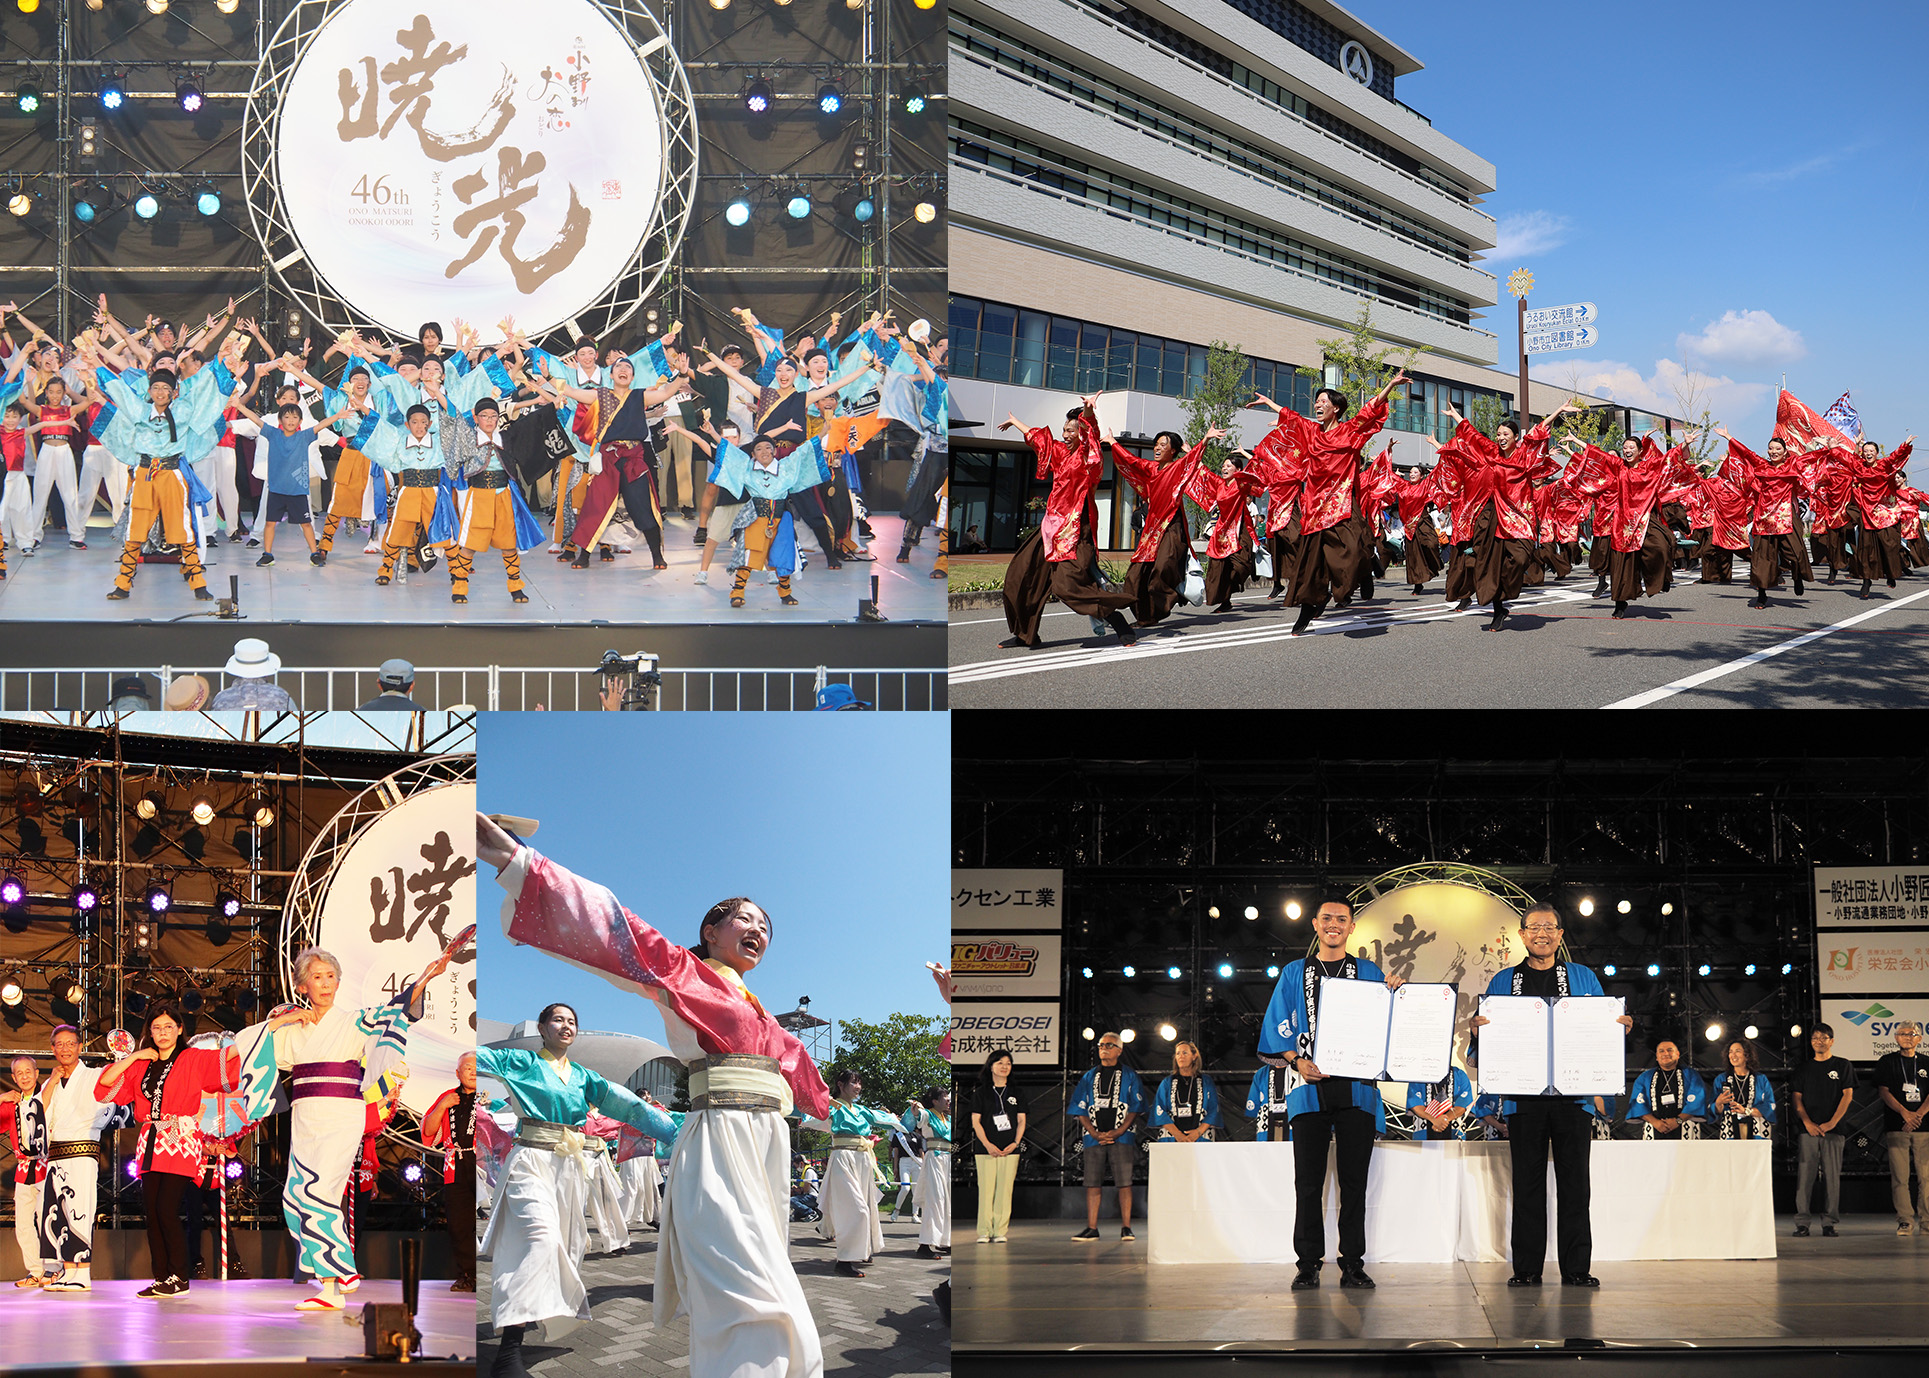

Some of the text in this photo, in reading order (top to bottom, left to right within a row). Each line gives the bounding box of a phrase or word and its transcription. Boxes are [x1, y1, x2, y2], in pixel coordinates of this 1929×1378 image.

[350, 173, 410, 205] 46th
[348, 207, 413, 216] ONO MATSURI
[431, 170, 443, 242] ぎょうこう
[385, 218, 414, 226] ODORI
[1526, 307, 1574, 323] うるおい交流館
[1526, 330, 1574, 346] 小野市立図書館
[1541, 343, 1552, 351] City
[1553, 341, 1574, 350] Library
[951, 888, 1055, 908] クセン工業
[449, 971, 460, 1034] ぎょうこう
